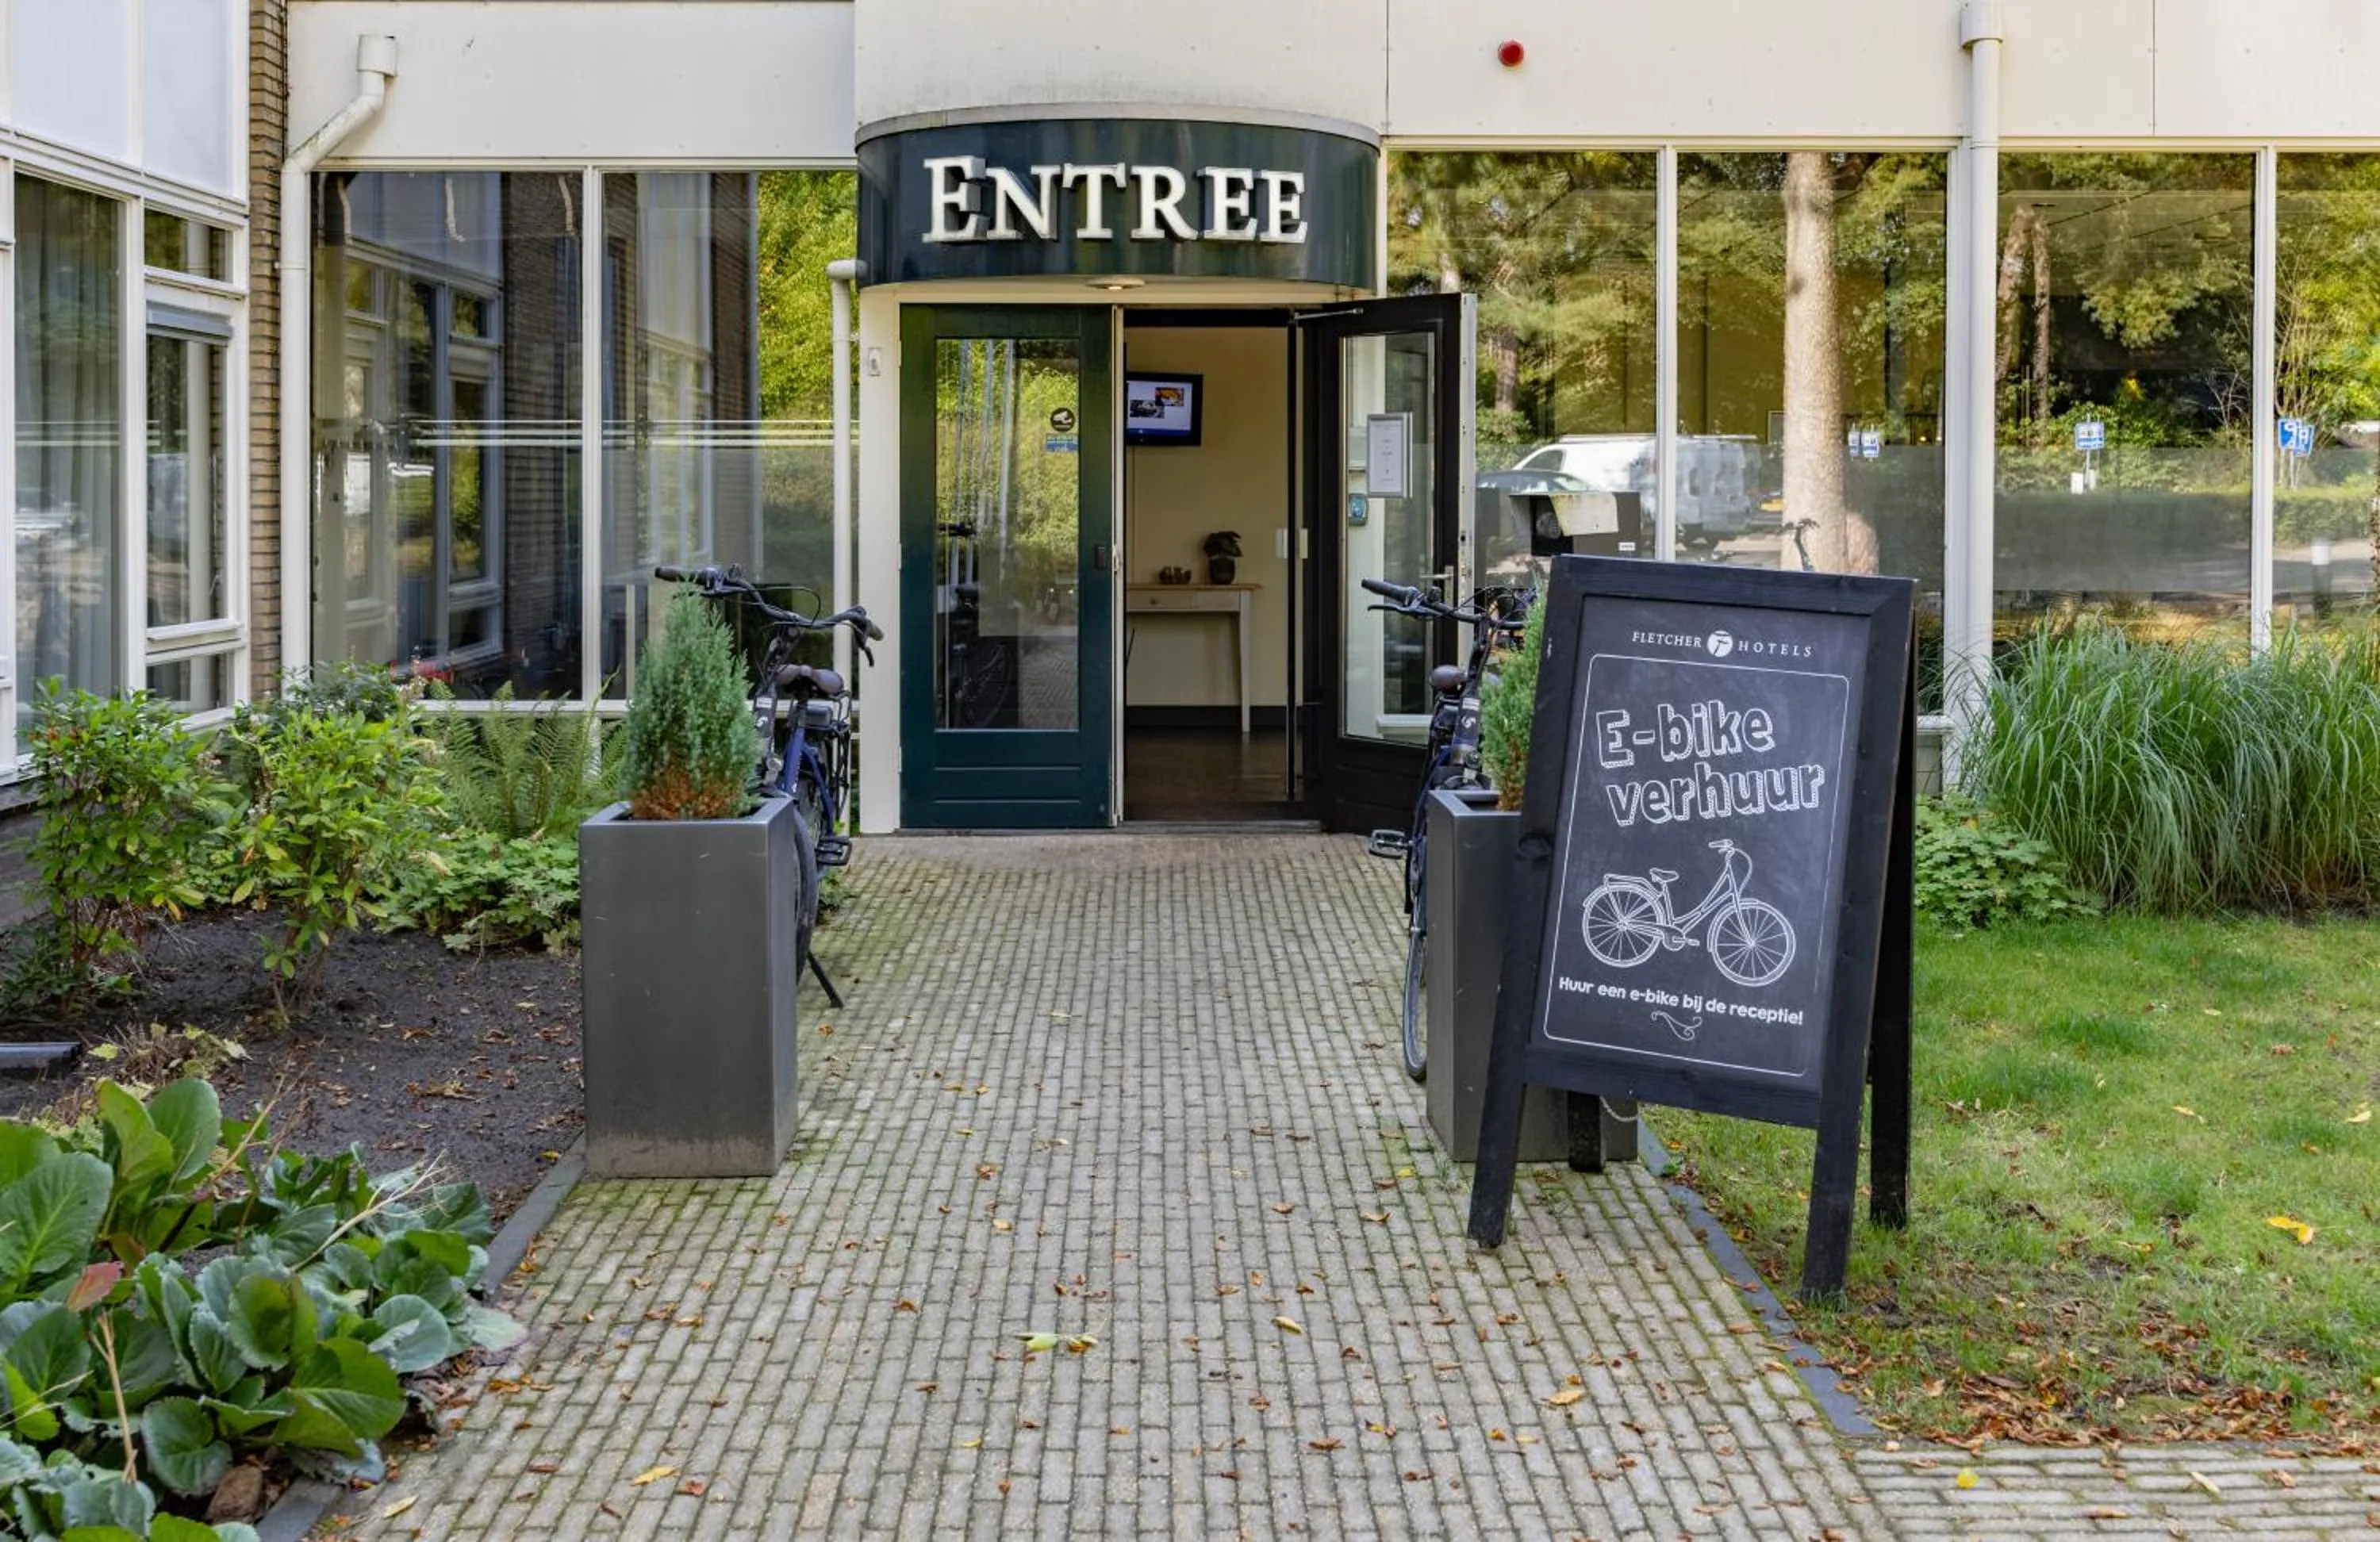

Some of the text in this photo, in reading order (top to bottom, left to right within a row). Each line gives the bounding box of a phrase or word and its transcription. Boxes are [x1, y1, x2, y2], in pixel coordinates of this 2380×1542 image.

[922, 154, 1309, 244] ENTREE
[1632, 631, 1813, 658] FLETCHER HOTELS
[1595, 700, 1776, 769] E-bike
[1606, 761, 1825, 826] verhuur
[1559, 976, 1804, 1026] Huur een e-bike bij de receptie!
